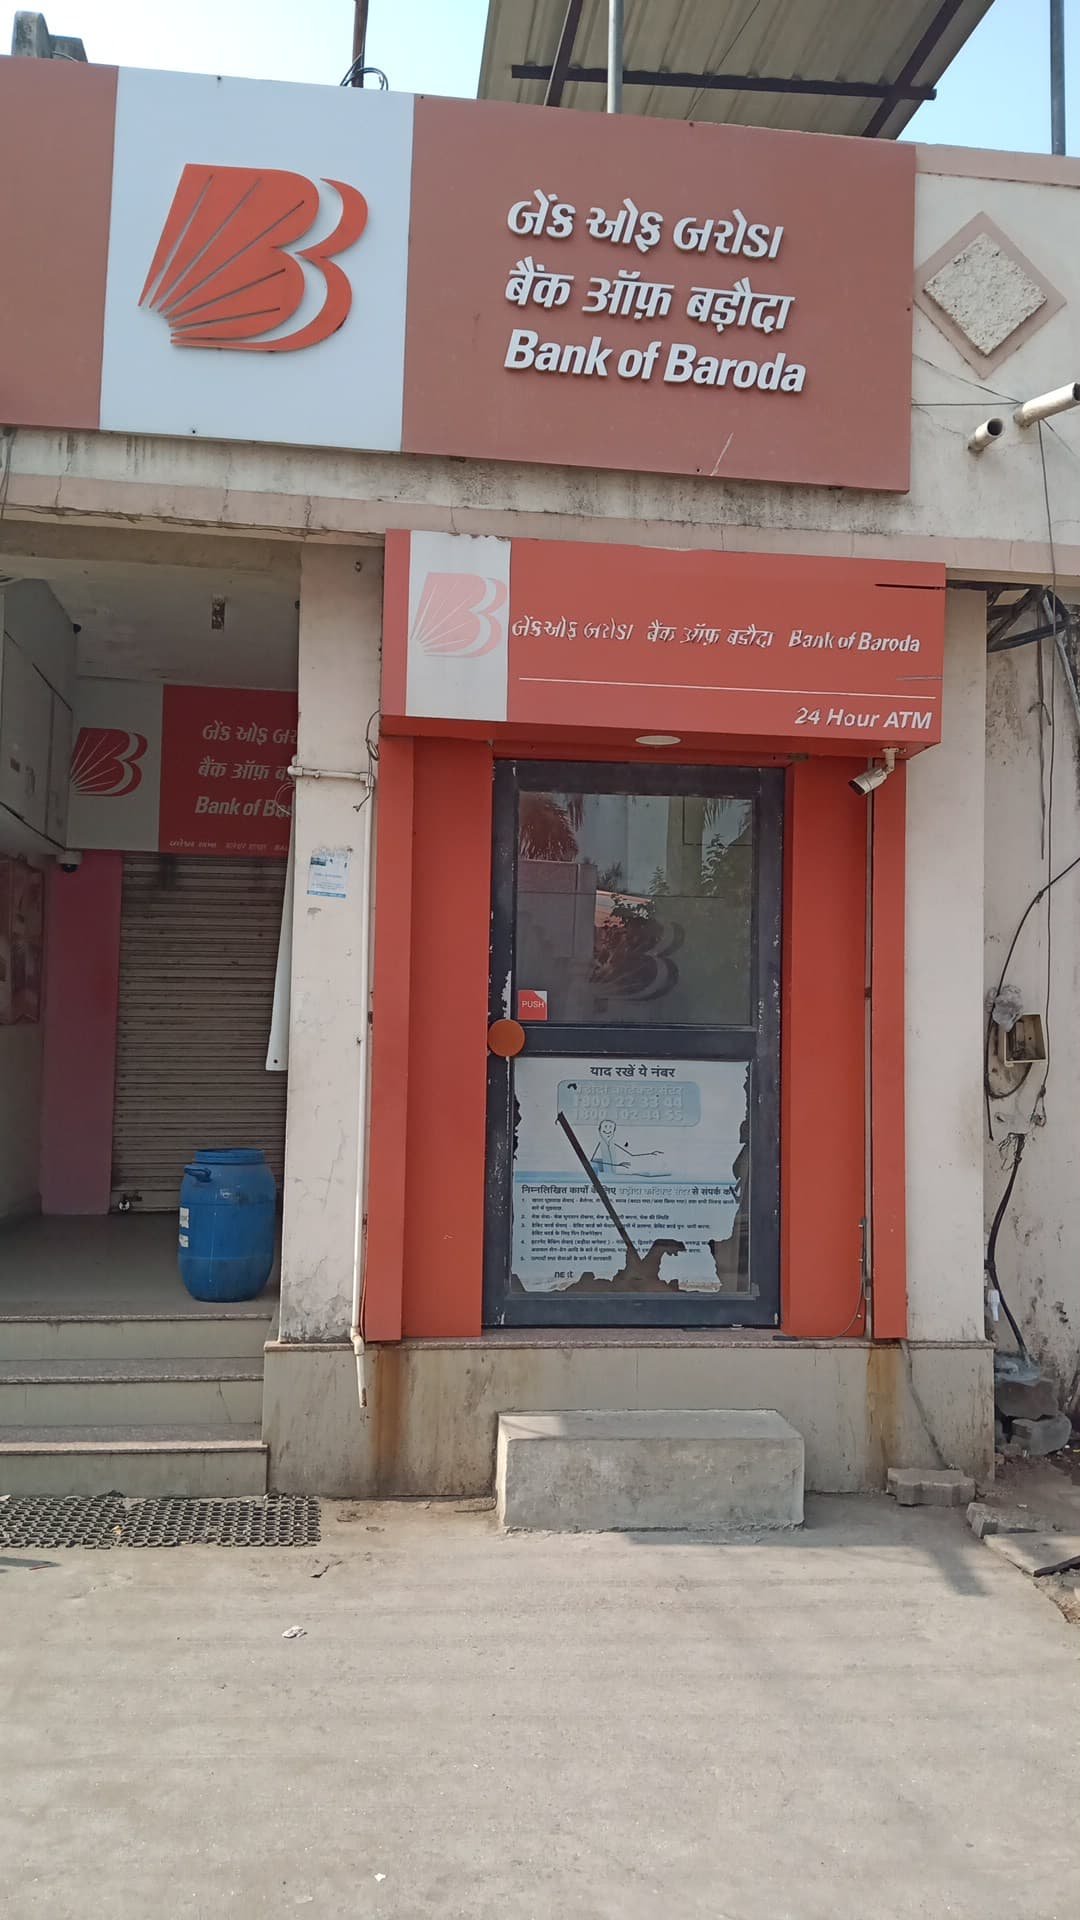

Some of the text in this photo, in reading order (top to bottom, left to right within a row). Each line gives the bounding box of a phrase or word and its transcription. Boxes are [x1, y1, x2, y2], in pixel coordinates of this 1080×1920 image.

[507, 188, 784, 259] બેંક ઓફ બરોડા
[504, 255, 796, 333] बैंक ऑफ़ बड़ौदा
[504, 328, 807, 392] Bank of Baroda
[584, 617, 634, 641] બરોડા
[647, 619, 678, 643] बैंक
[788, 628, 921, 652] Bank of Baroda
[794, 707, 933, 730] 24 Hour ATM
[202, 720, 232, 741] બેંક
[236, 722, 268, 746] ઓફ
[198, 755, 228, 777] बैंक
[231, 760, 271, 780] ऑफ़
[194, 796, 240, 815] Bank
[242, 798, 262, 816] of
[521, 1000, 545, 1008] PUSH
[590, 1064, 676, 1077] याद रखें ये नंबर
[521, 1184, 567, 1194] निम्नलिखित
[692, 1186, 699, 1195] से
[701, 1186, 721, 1196] संपर्क
